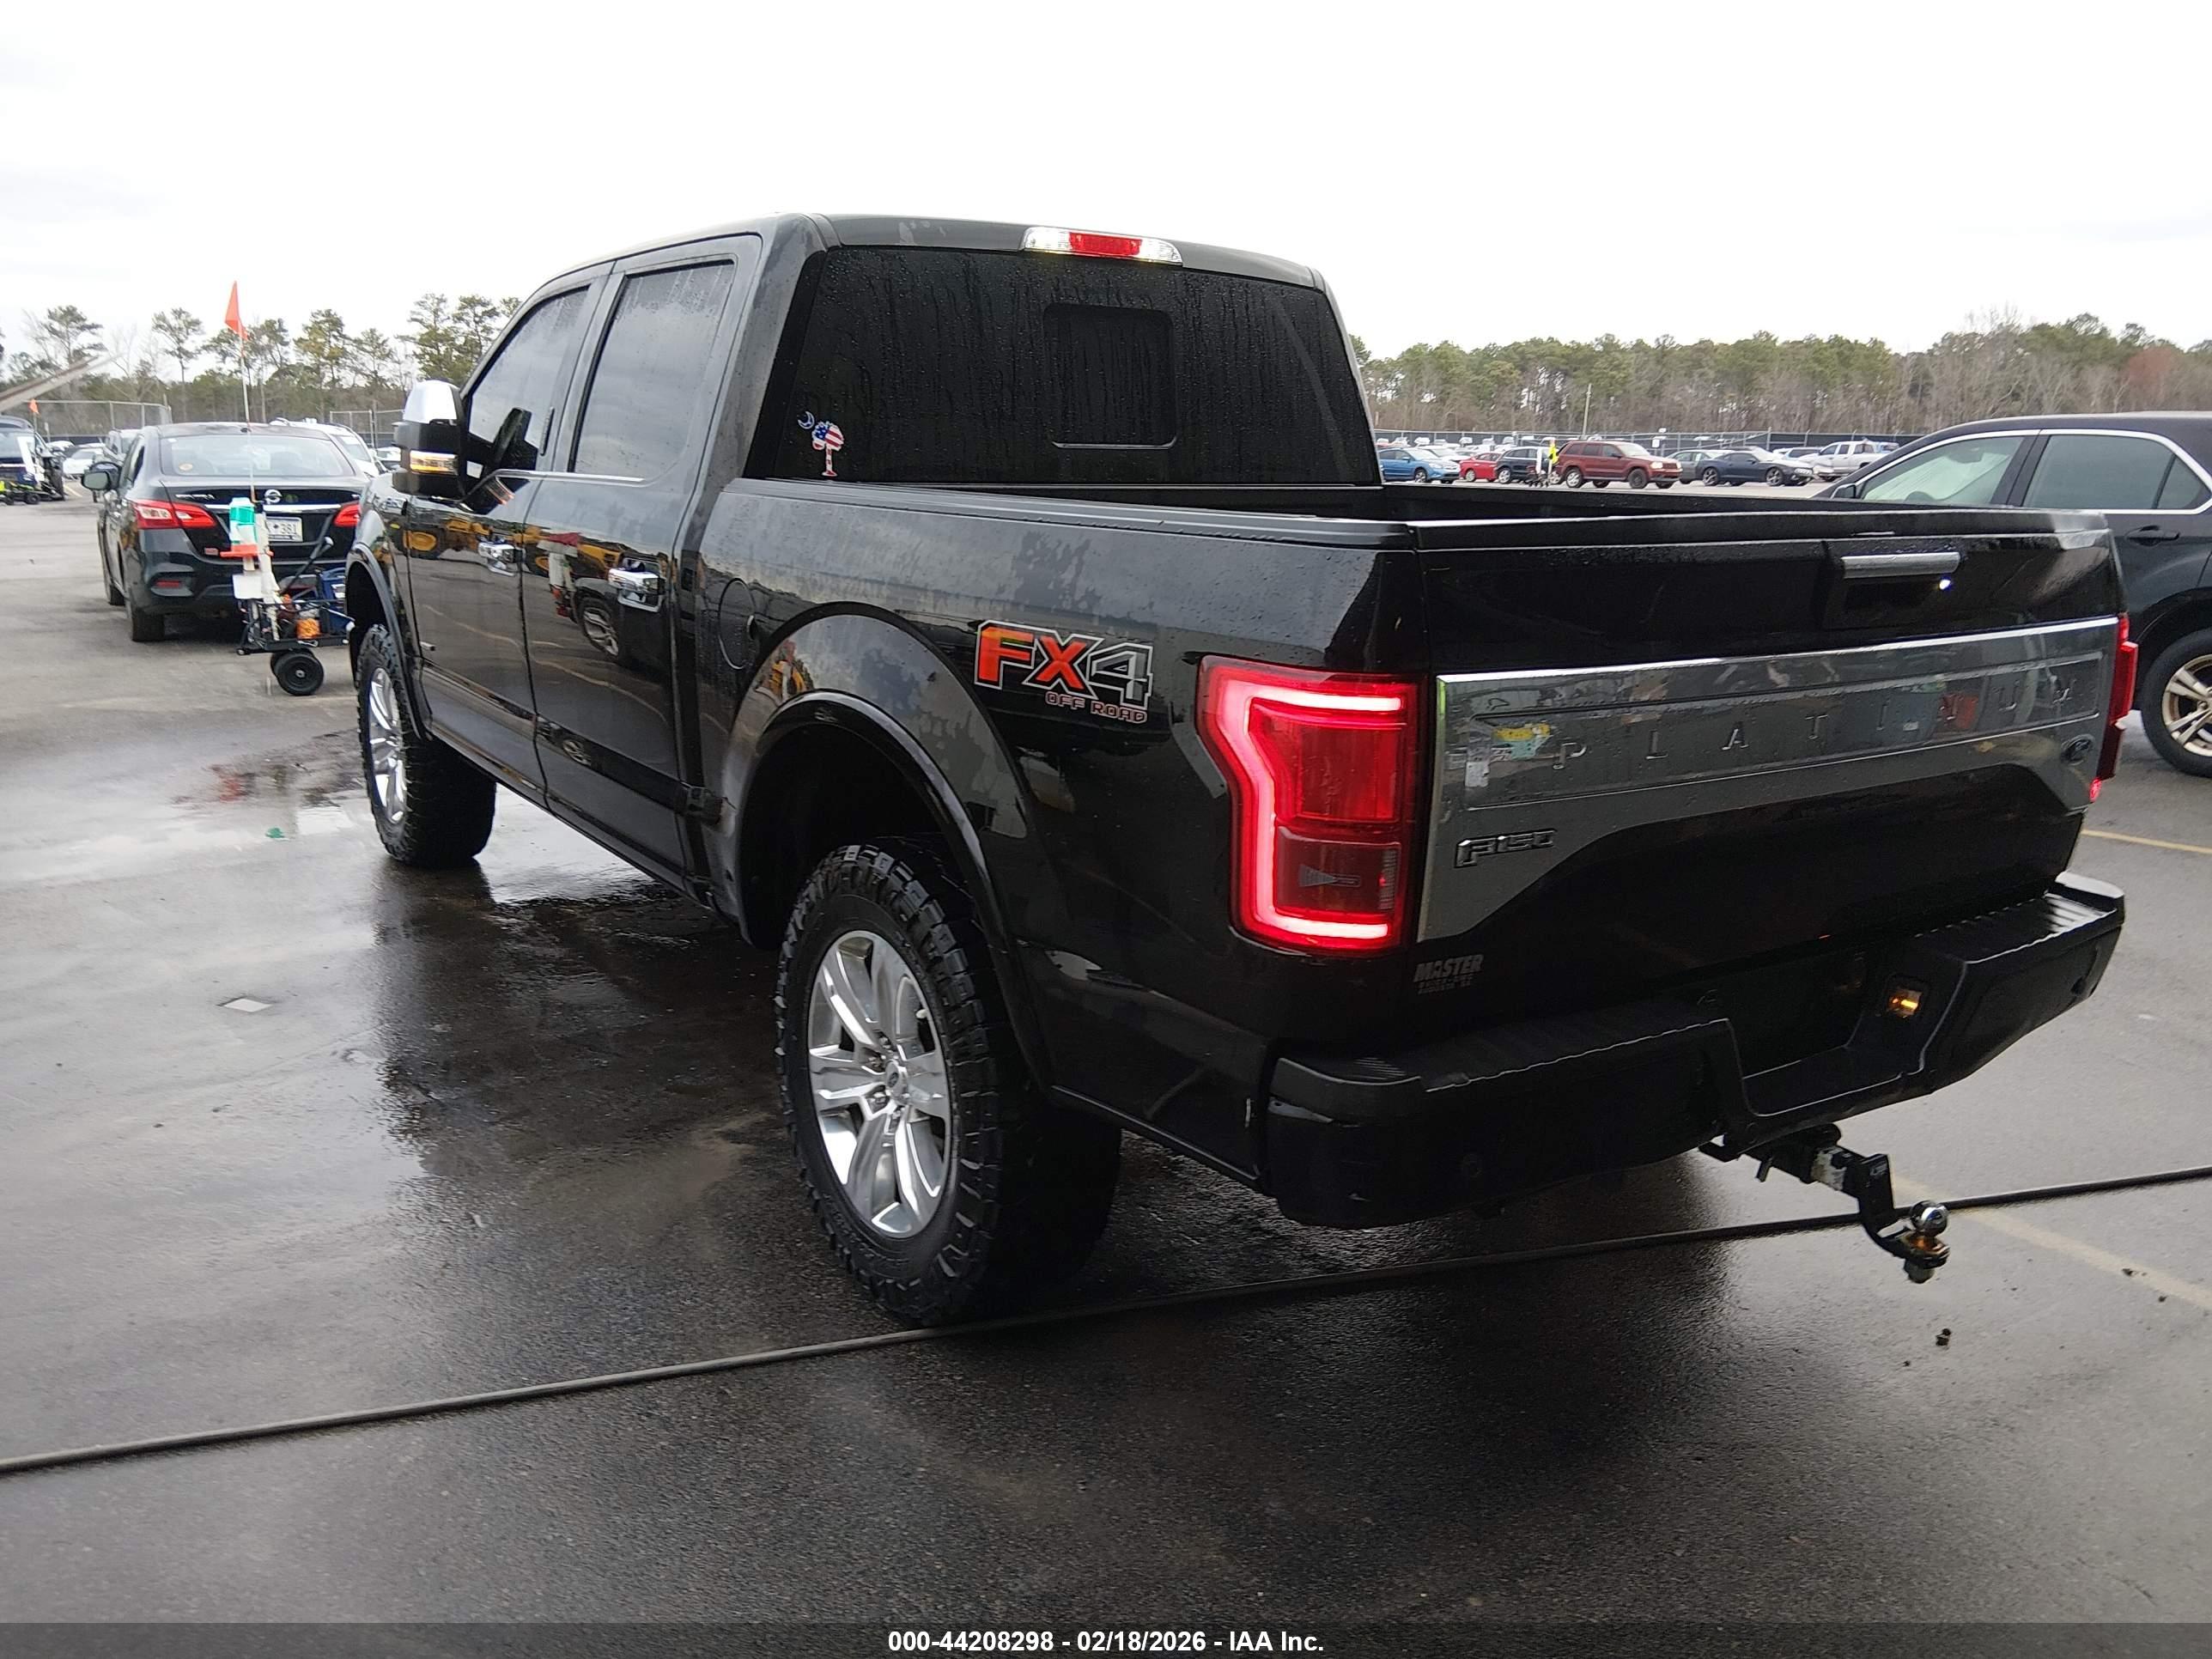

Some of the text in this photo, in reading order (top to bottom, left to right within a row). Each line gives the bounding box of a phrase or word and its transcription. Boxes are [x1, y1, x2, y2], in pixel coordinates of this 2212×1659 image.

[975, 620, 1153, 710] FX4
[1045, 690, 1148, 724] OFF ROAD
[1552, 679, 2077, 769] PLATINUM
[1413, 954, 1484, 982] MASTER
